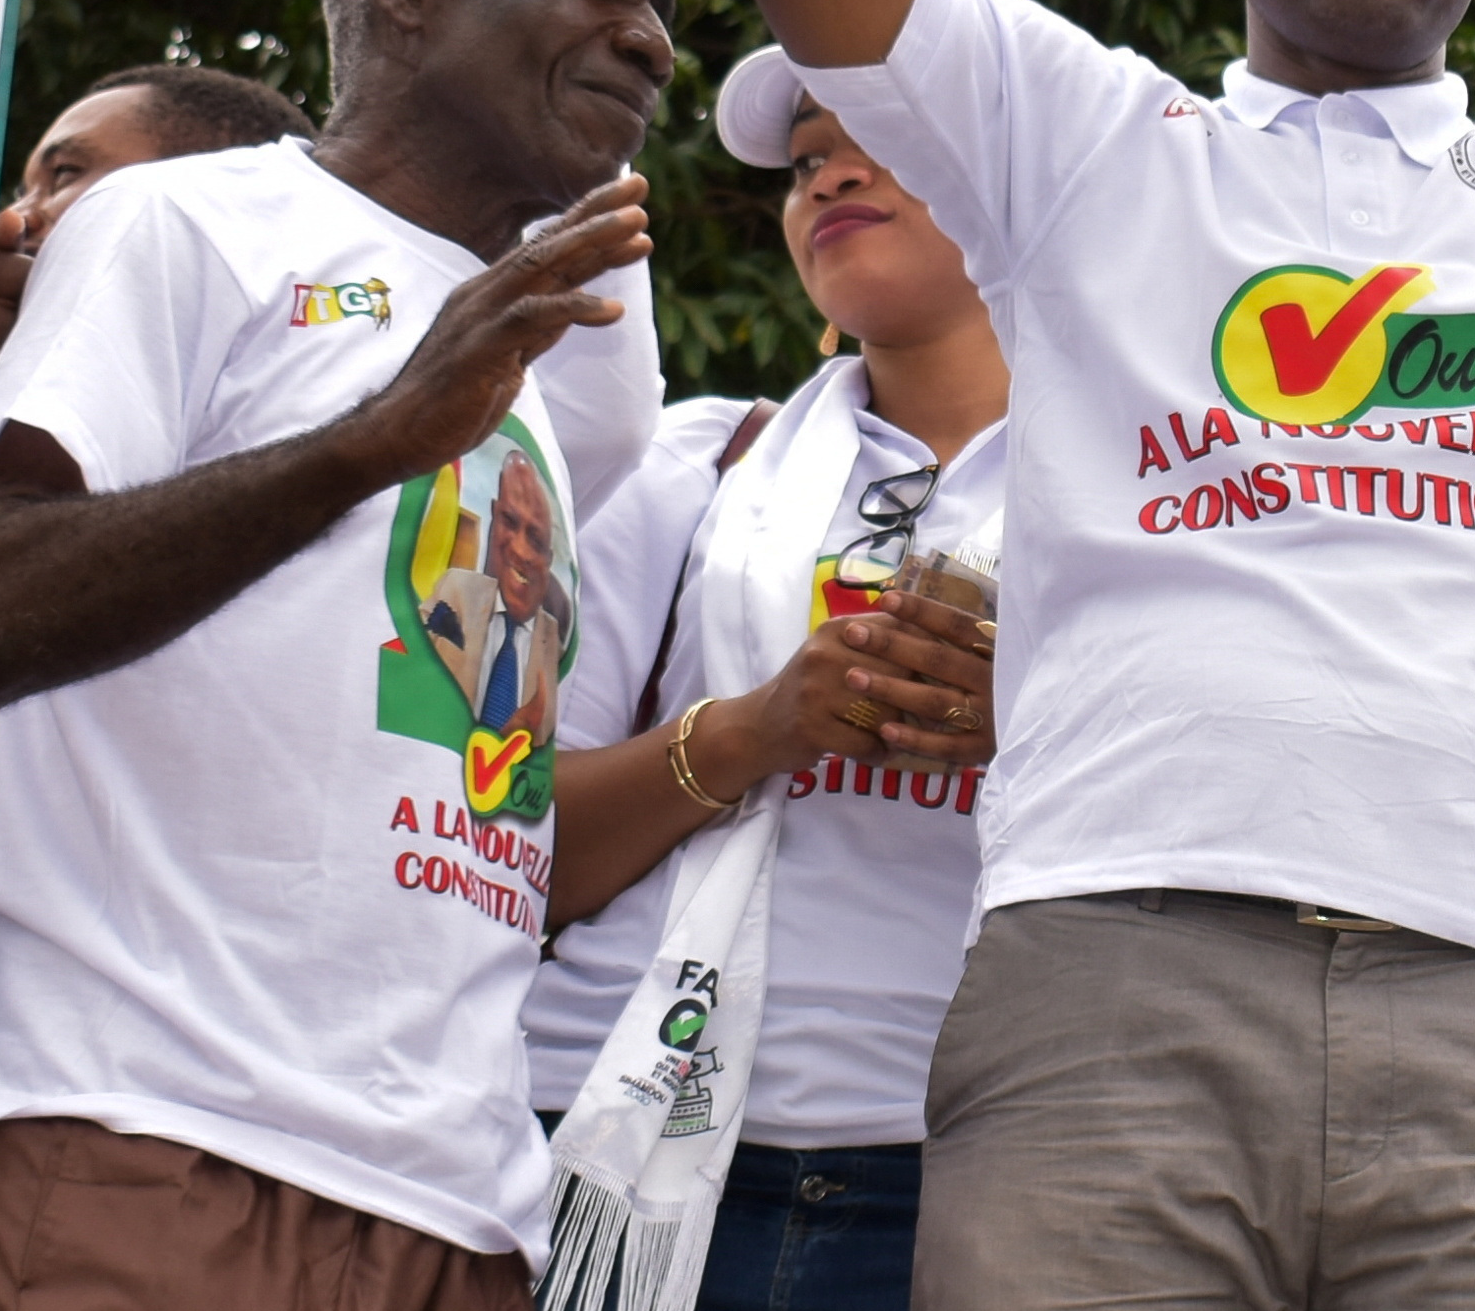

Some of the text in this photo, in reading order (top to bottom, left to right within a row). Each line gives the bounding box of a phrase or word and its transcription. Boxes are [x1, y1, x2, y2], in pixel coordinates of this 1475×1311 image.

[1138, 424, 1172, 479] A
[1168, 407, 1241, 463] LA
[390, 796, 420, 833] A
[434, 799, 469, 846] LA
